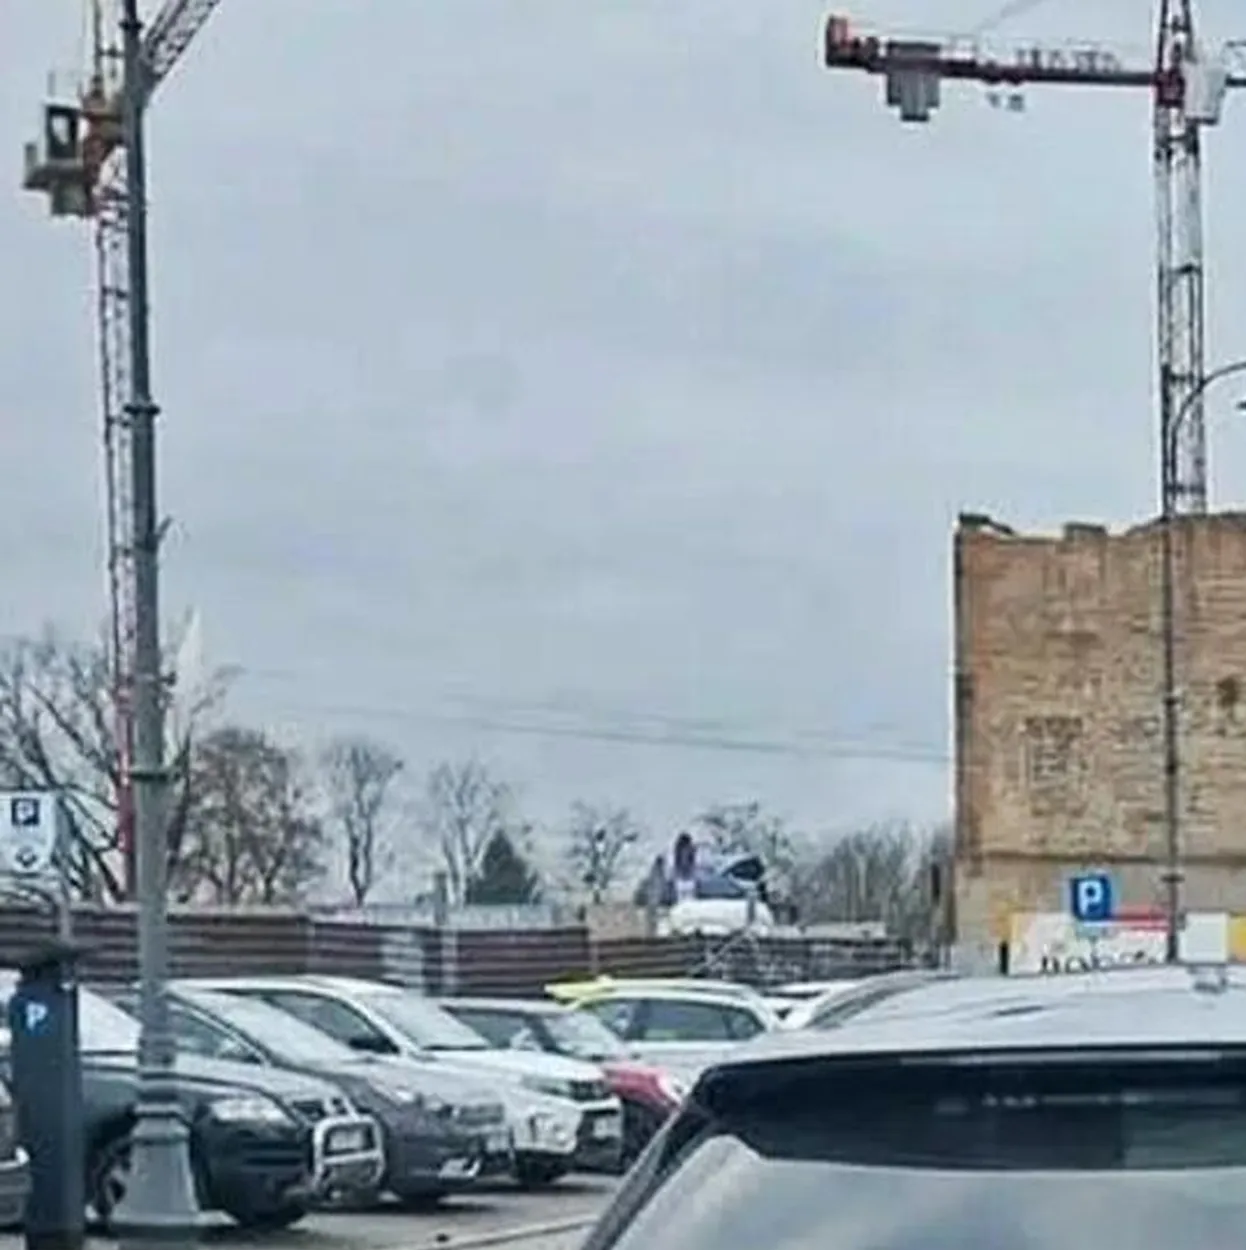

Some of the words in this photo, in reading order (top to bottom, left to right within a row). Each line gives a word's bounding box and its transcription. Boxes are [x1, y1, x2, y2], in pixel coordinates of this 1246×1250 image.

[16, 800, 35, 825] P
[1077, 880, 1104, 915] P
[26, 1002, 48, 1031] P
